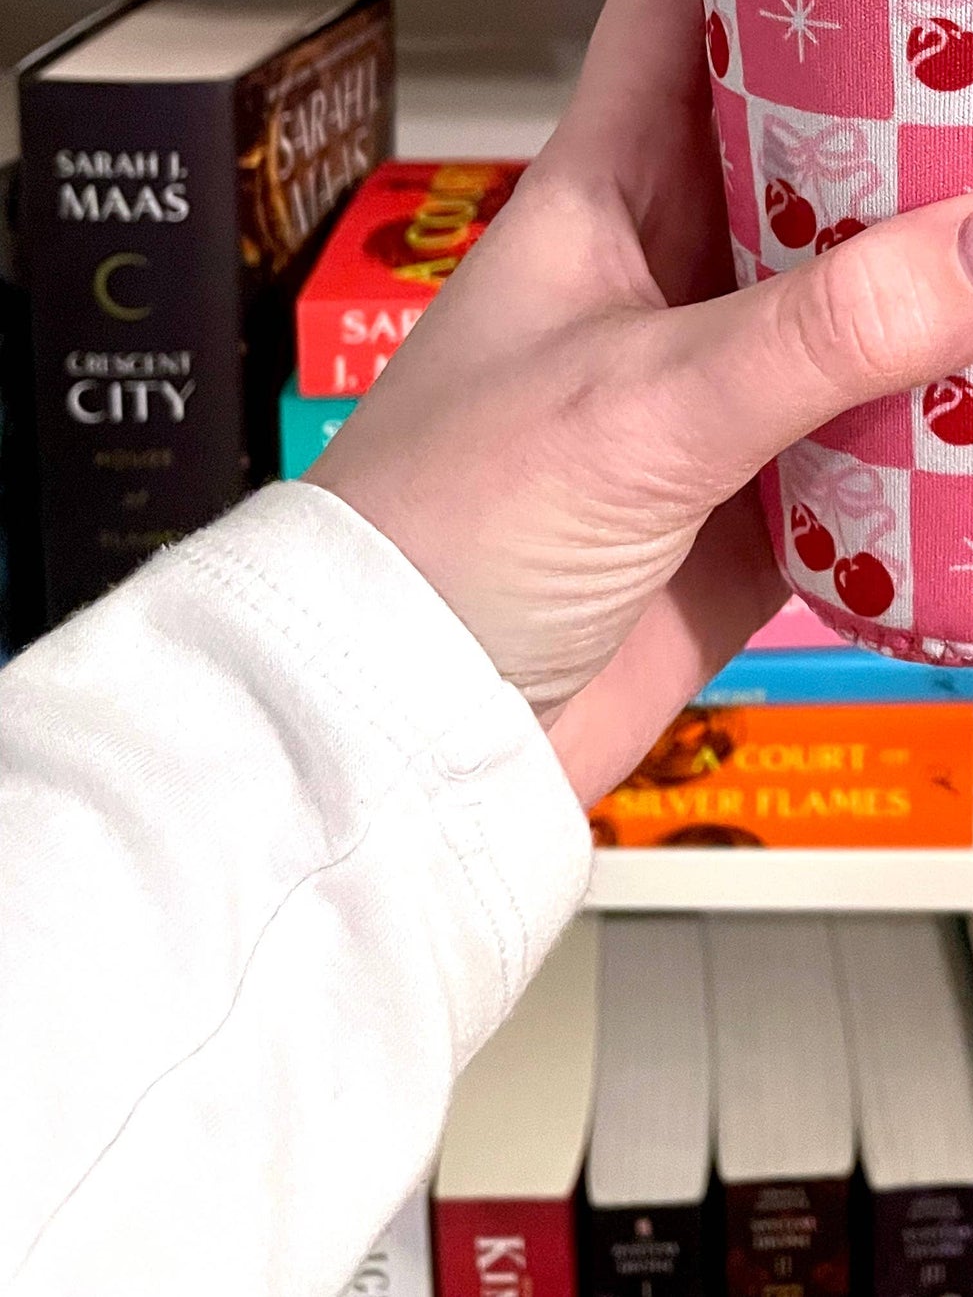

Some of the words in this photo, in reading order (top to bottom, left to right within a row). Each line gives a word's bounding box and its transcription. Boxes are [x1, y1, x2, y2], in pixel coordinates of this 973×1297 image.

[55, 148, 160, 179] SARAH
[58, 182, 190, 222] MAAS
[66, 378, 197, 424] CITY
[732, 742, 868, 773] COURT
[754, 787, 912, 819] FLAMES
